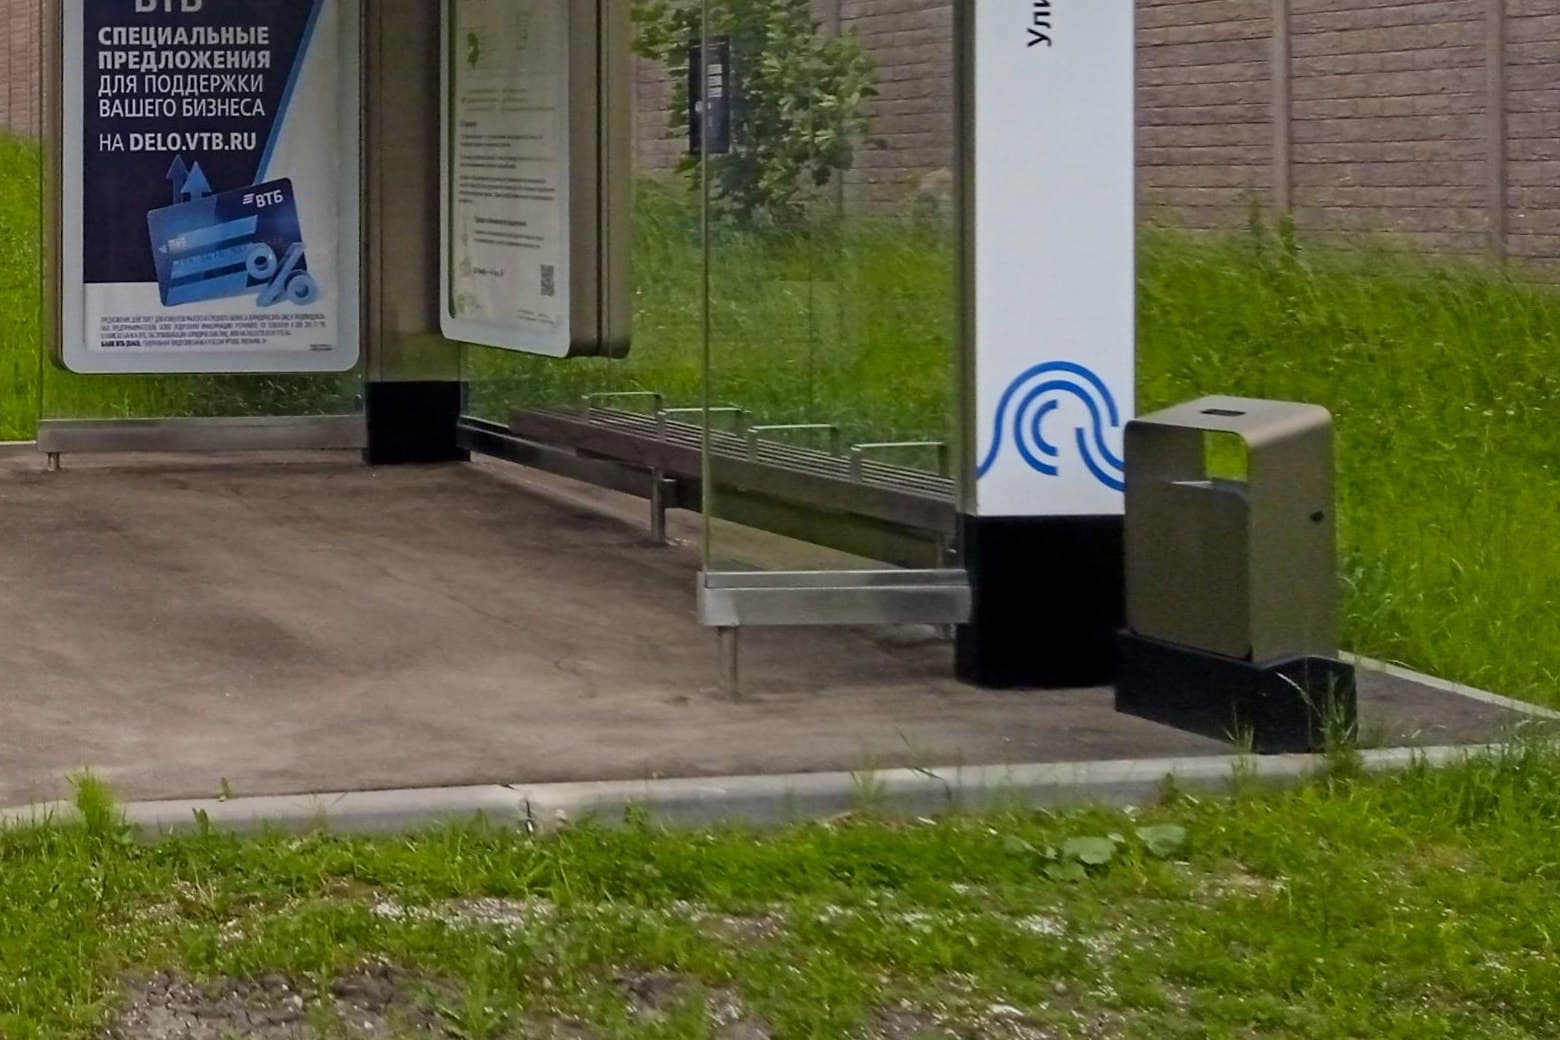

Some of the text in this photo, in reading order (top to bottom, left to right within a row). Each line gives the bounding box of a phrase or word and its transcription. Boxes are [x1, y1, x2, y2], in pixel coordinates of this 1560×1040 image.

[97, 26, 270, 49] СПЕЦИАЛЬНЫЕ
[97, 50, 271, 73] ПРЕДЛОЖЕНИЯ
[97, 73, 264, 97] ДЛЯ ПОДДЕРЖКИ
[98, 97, 266, 117] ВАШЕГО БИЗНЕСА
[98, 132, 257, 151] НА DELO.VTB.RU
[255, 189, 284, 208] ВТБ
